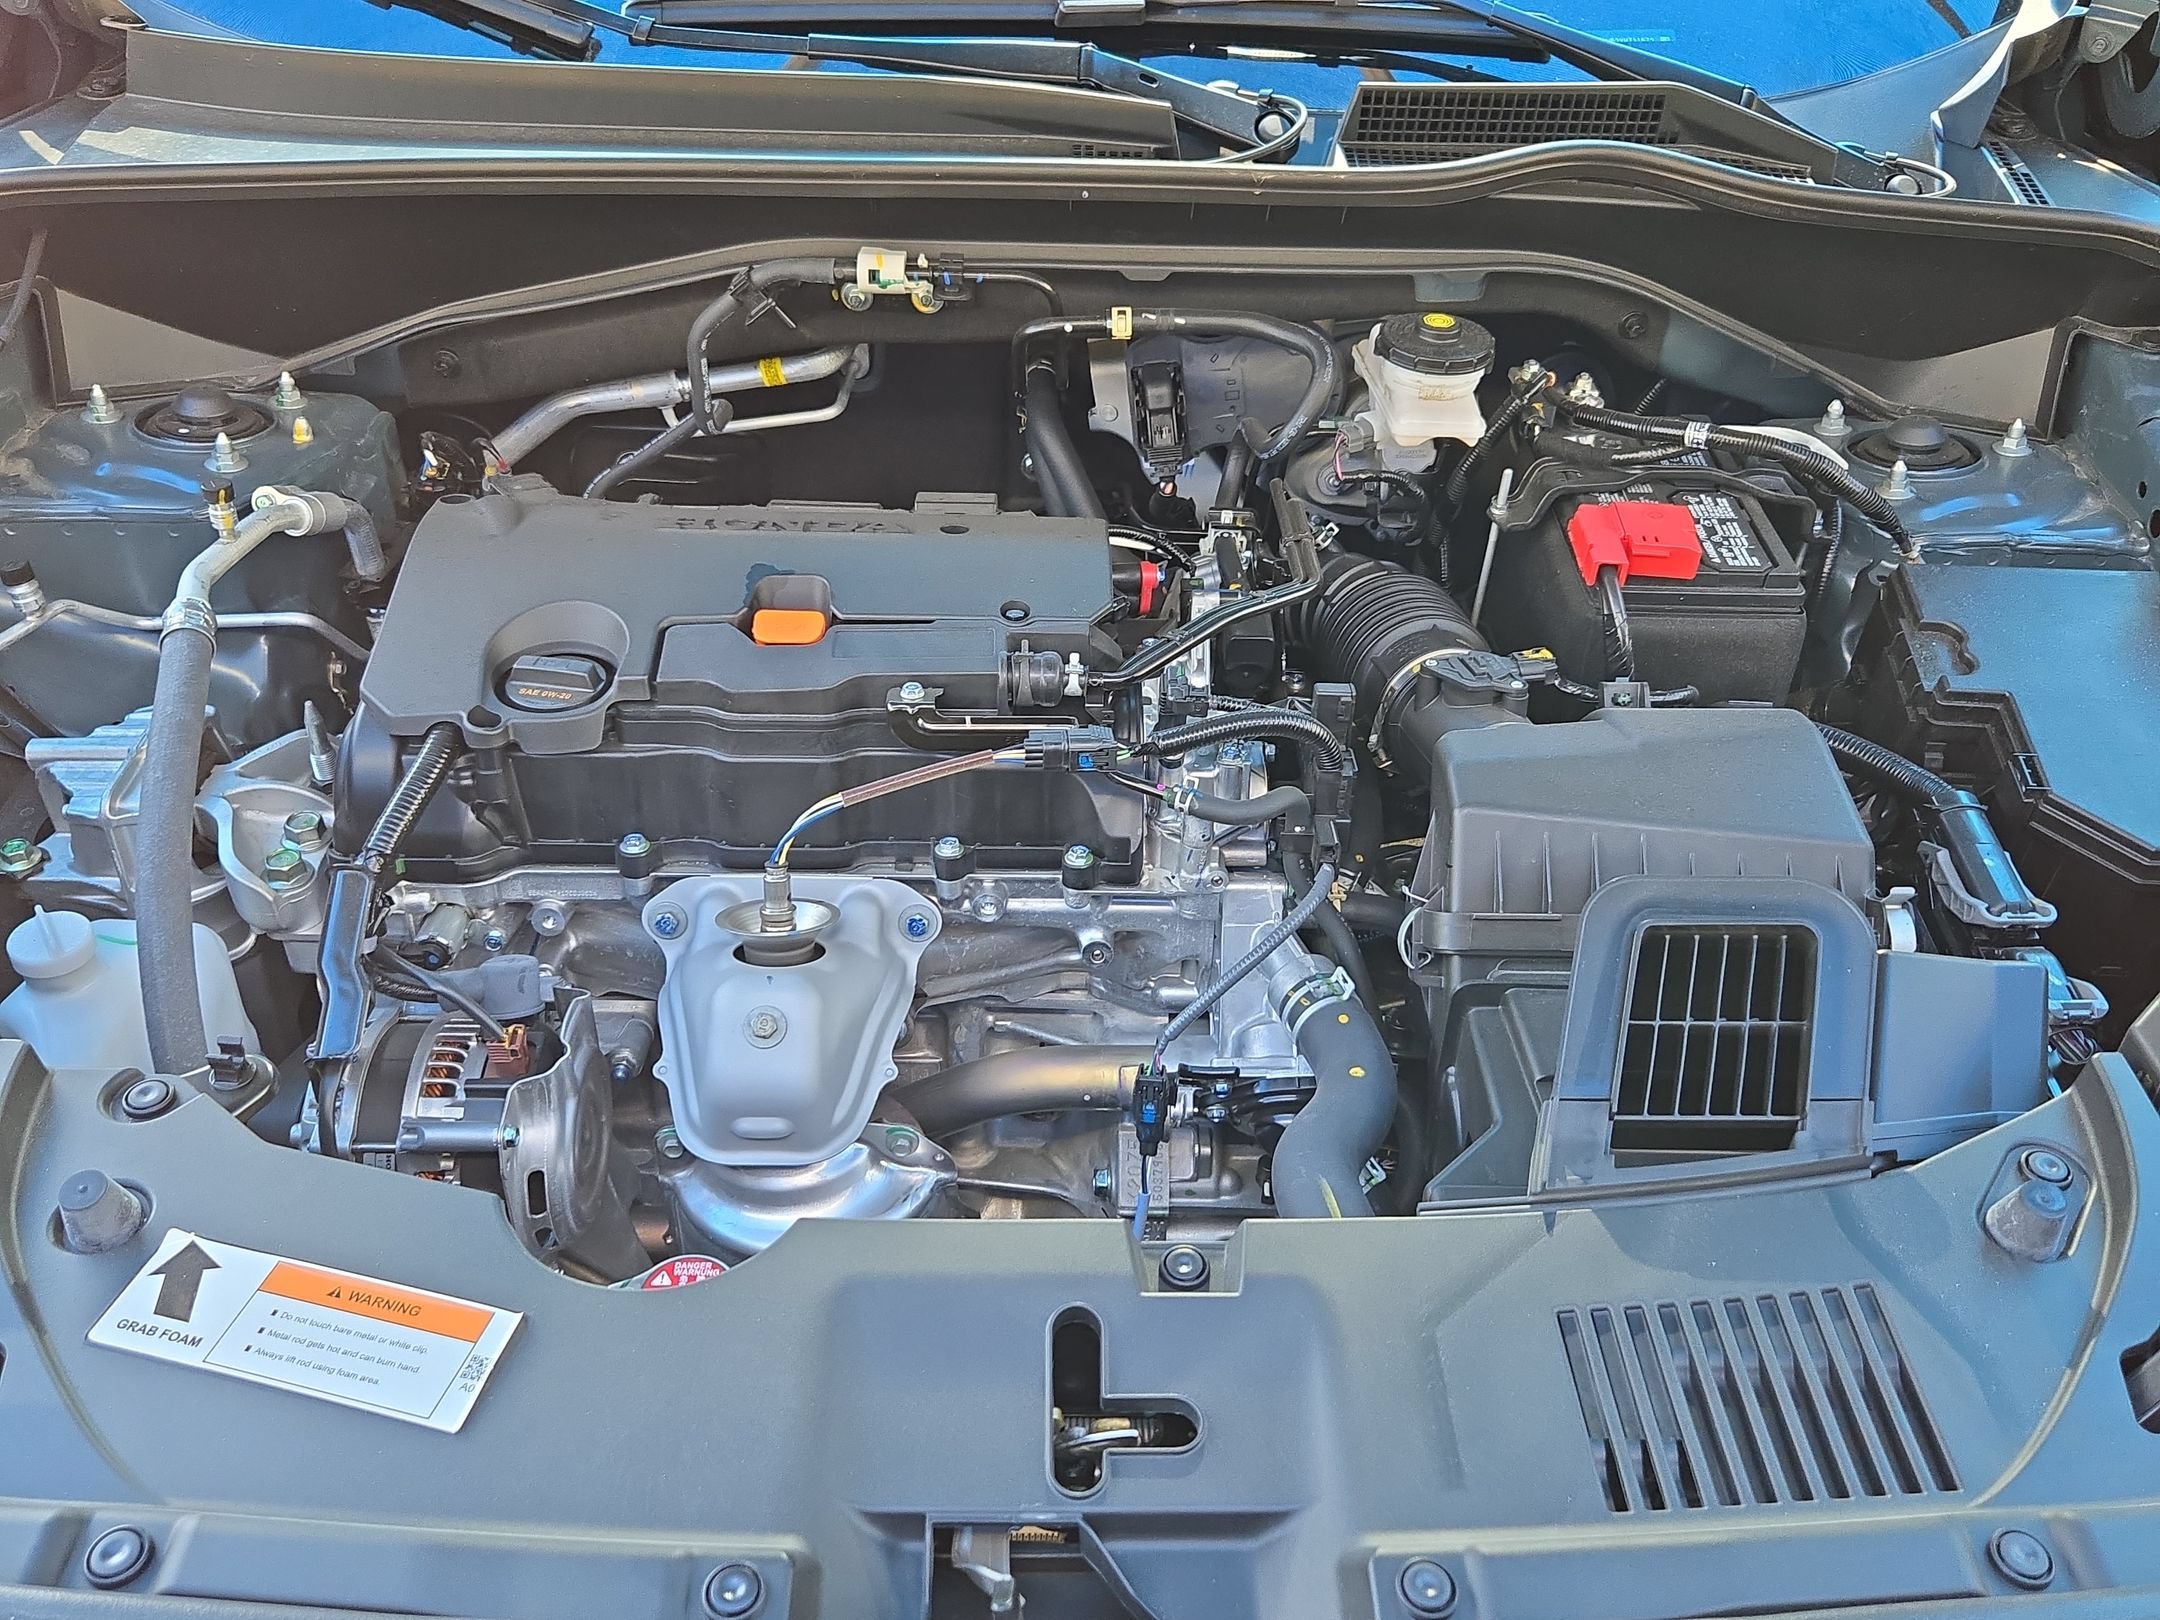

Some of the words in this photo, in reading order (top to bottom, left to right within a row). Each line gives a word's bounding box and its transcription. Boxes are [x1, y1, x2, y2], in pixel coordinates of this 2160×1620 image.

[518, 687, 540, 697] SAE
[541, 689, 573, 700] 0W-20
[674, 1261, 713, 1270] DANGER
[348, 1289, 422, 1317] WARNING
[116, 1318, 159, 1337] GRAB
[159, 1328, 204, 1348] FOAM
[280, 1311, 293, 1320] Do
[293, 1316, 308, 1325] not
[309, 1319, 332, 1330] touch
[333, 1325, 353, 1336] bare
[353, 1330, 378, 1342] metal
[378, 1336, 387, 1344] or
[388, 1338, 411, 1351] white
[267, 1329, 291, 1341] Metal
[291, 1336, 307, 1345] rod
[306, 1340, 326, 1350] gets
[326, 1344, 341, 1354] hot
[341, 1349, 360, 1359] and
[359, 1353, 376, 1363] can
[376, 1357, 396, 1368] burn
[254, 1347, 284, 1361] Always
[285, 1354, 297, 1364] lift
[296, 1359, 312, 1368] rod
[312, 1363, 336, 1375] using
[337, 1367, 359, 1380] foam
[459, 1382, 476, 1393] A0
